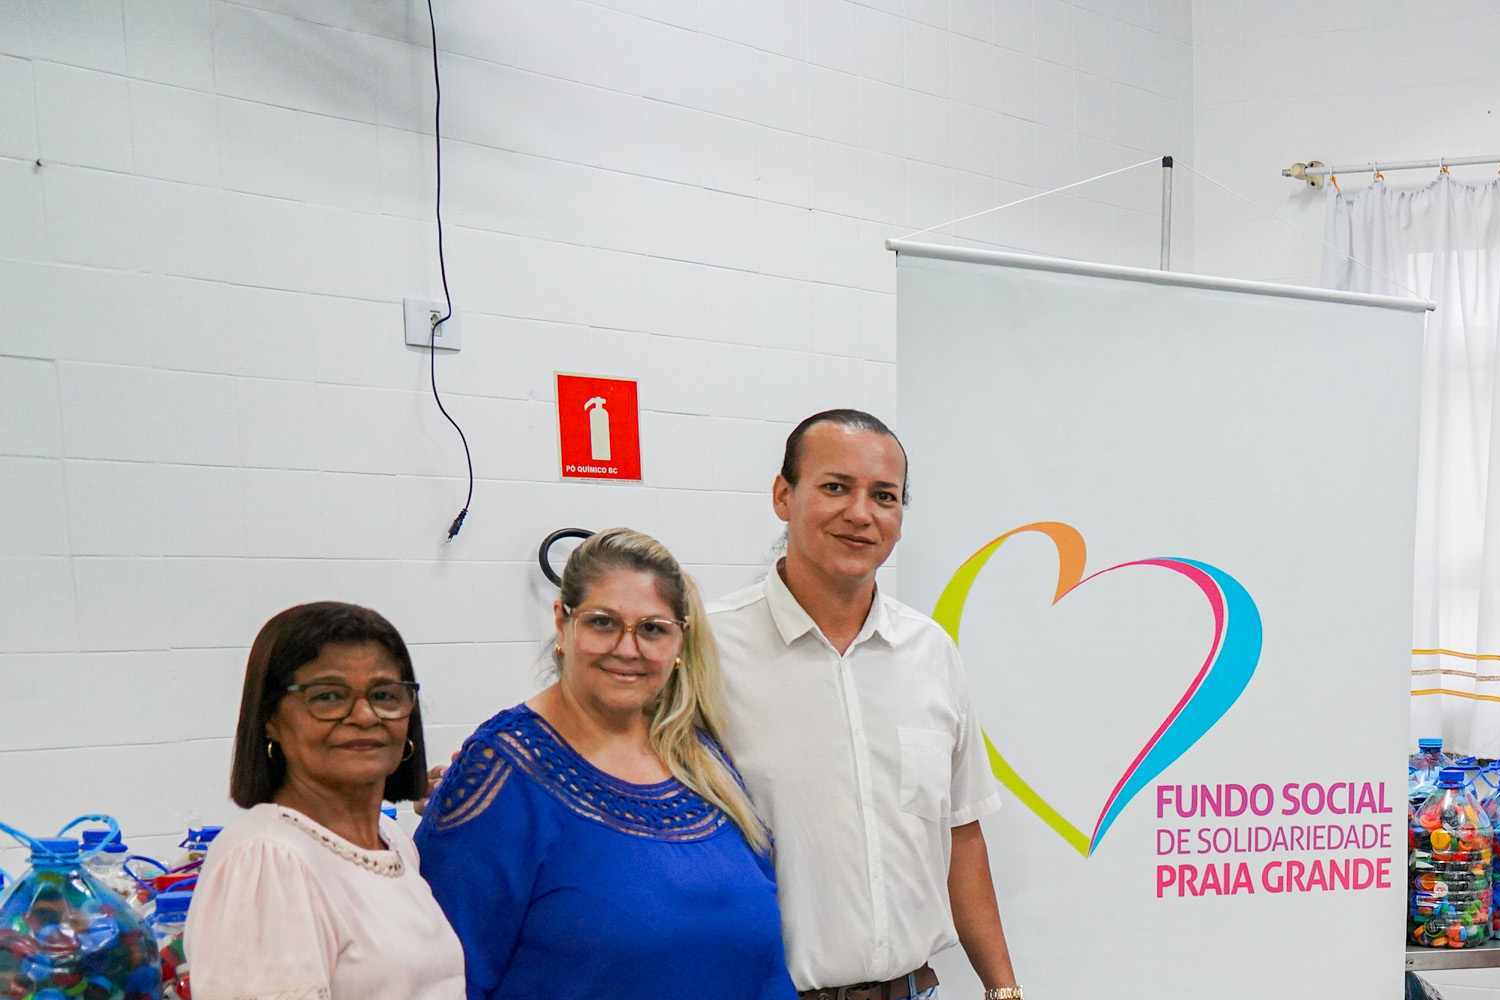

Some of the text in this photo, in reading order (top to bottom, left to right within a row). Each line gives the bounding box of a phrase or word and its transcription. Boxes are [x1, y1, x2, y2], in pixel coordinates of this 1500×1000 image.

[566, 464, 618, 475] PÓ QUÍMICO BC
[1156, 782, 1393, 818] FUNDO SOCIAL
[1156, 824, 1392, 855] DE SOLIDARIEDADE
[1156, 857, 1392, 898] PRAIA GRANDE
